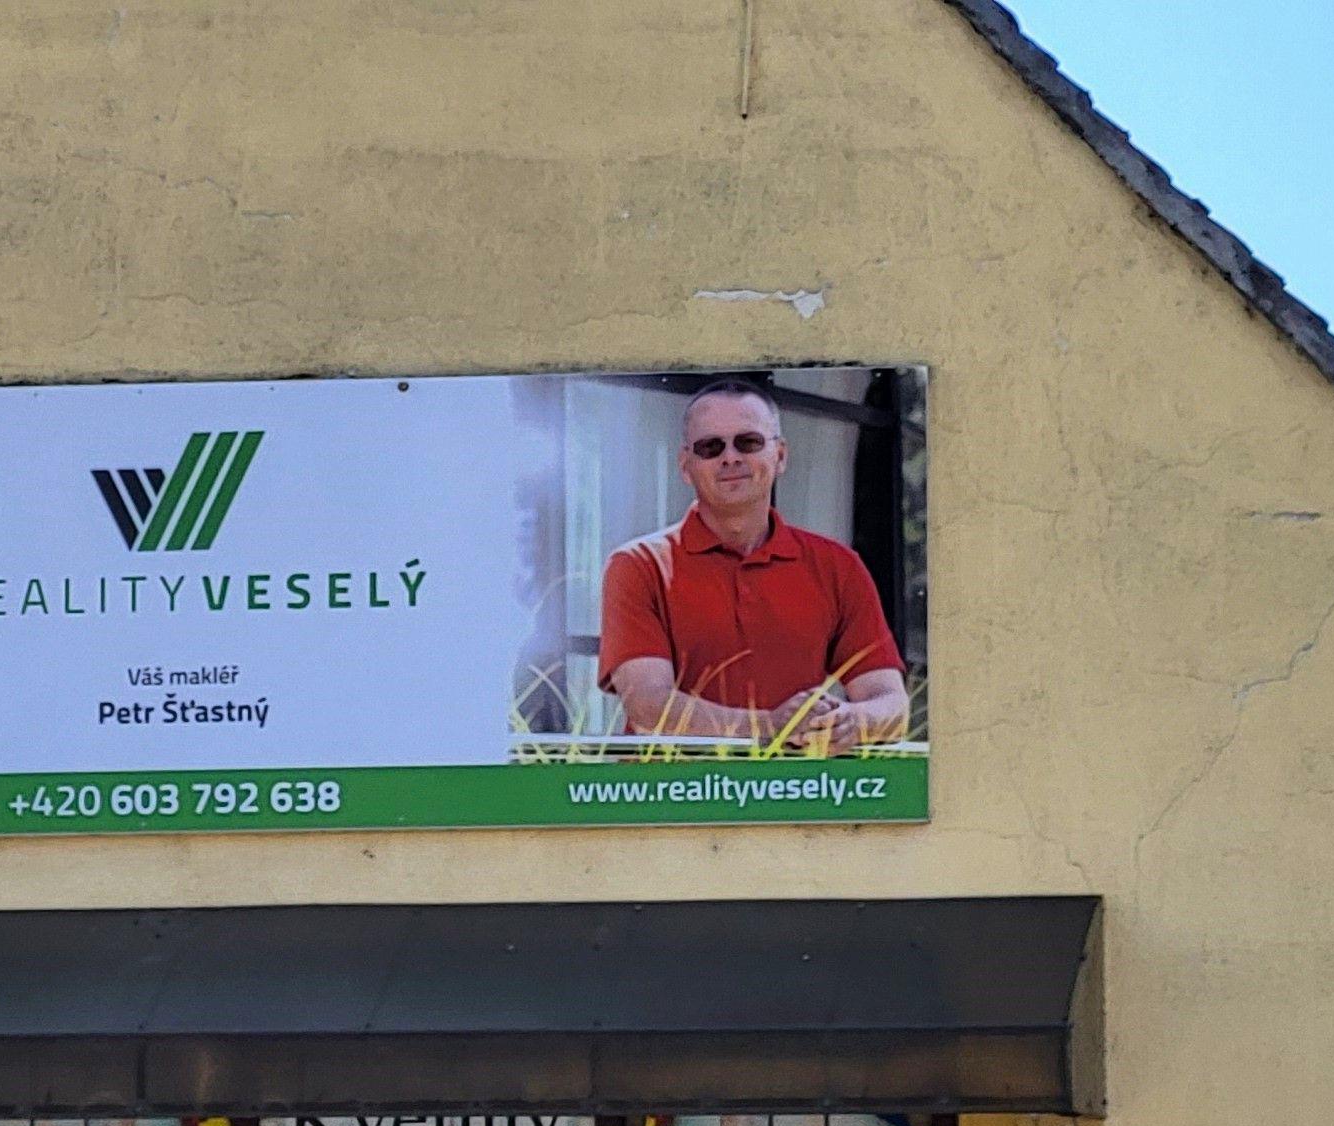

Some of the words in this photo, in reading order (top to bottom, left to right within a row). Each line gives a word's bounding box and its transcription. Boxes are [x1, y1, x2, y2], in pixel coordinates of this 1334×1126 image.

[127, 666, 164, 686] Váš
[169, 664, 240, 685] makléř
[98, 701, 155, 724] Petr
[163, 692, 269, 728] Šťastný
[8, 785, 102, 817] +420
[110, 783, 180, 816] 603
[192, 782, 260, 815] 792
[270, 781, 341, 813] 638
[568, 772, 887, 808] www.realityvesely.cz
